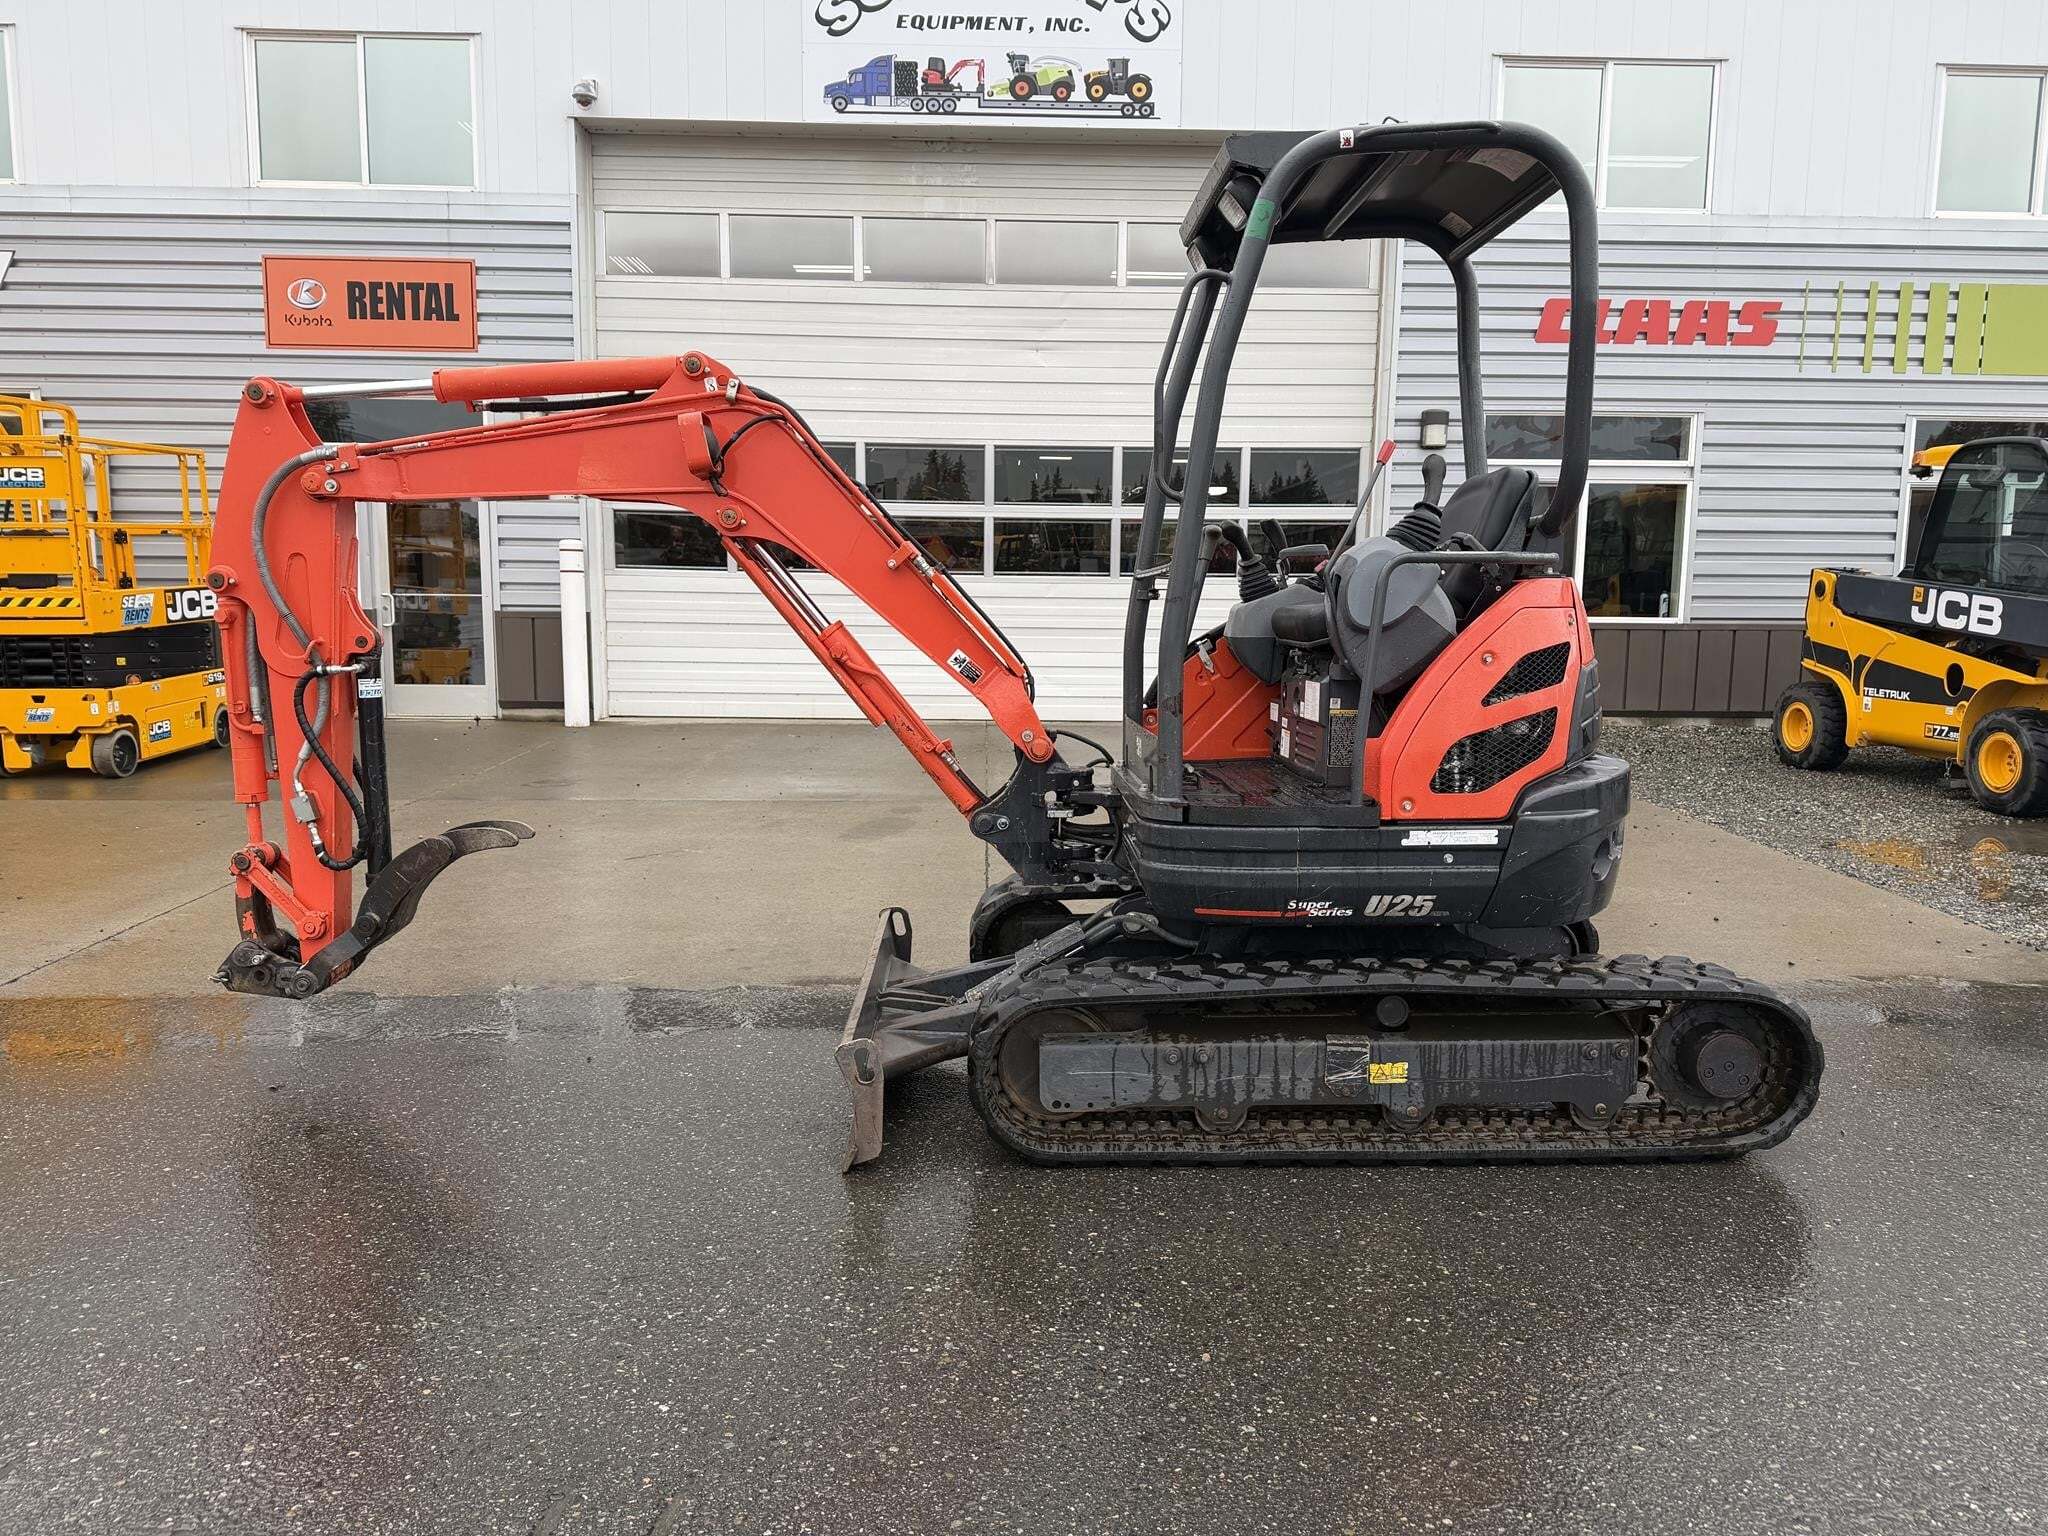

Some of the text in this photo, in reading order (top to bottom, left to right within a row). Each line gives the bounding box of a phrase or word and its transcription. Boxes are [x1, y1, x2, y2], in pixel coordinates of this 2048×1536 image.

[896, 14, 1035, 34] EQUIPMENT,
[1044, 17, 1091, 33] INC.
[346, 281, 459, 321] RENTAL
[285, 314, 333, 327] Kubota
[1534, 298, 1783, 347] CLAAS
[0, 467, 45, 481] JCB
[167, 589, 219, 620] JCB
[1911, 588, 2004, 636] JCB
[124, 608, 150, 621] RENTS
[1863, 687, 1911, 701] TELETRUK
[149, 720, 171, 735] JCB
[1287, 900, 1332, 911] Super
[1308, 907, 1353, 917] Series
[1363, 895, 1438, 917] U25
